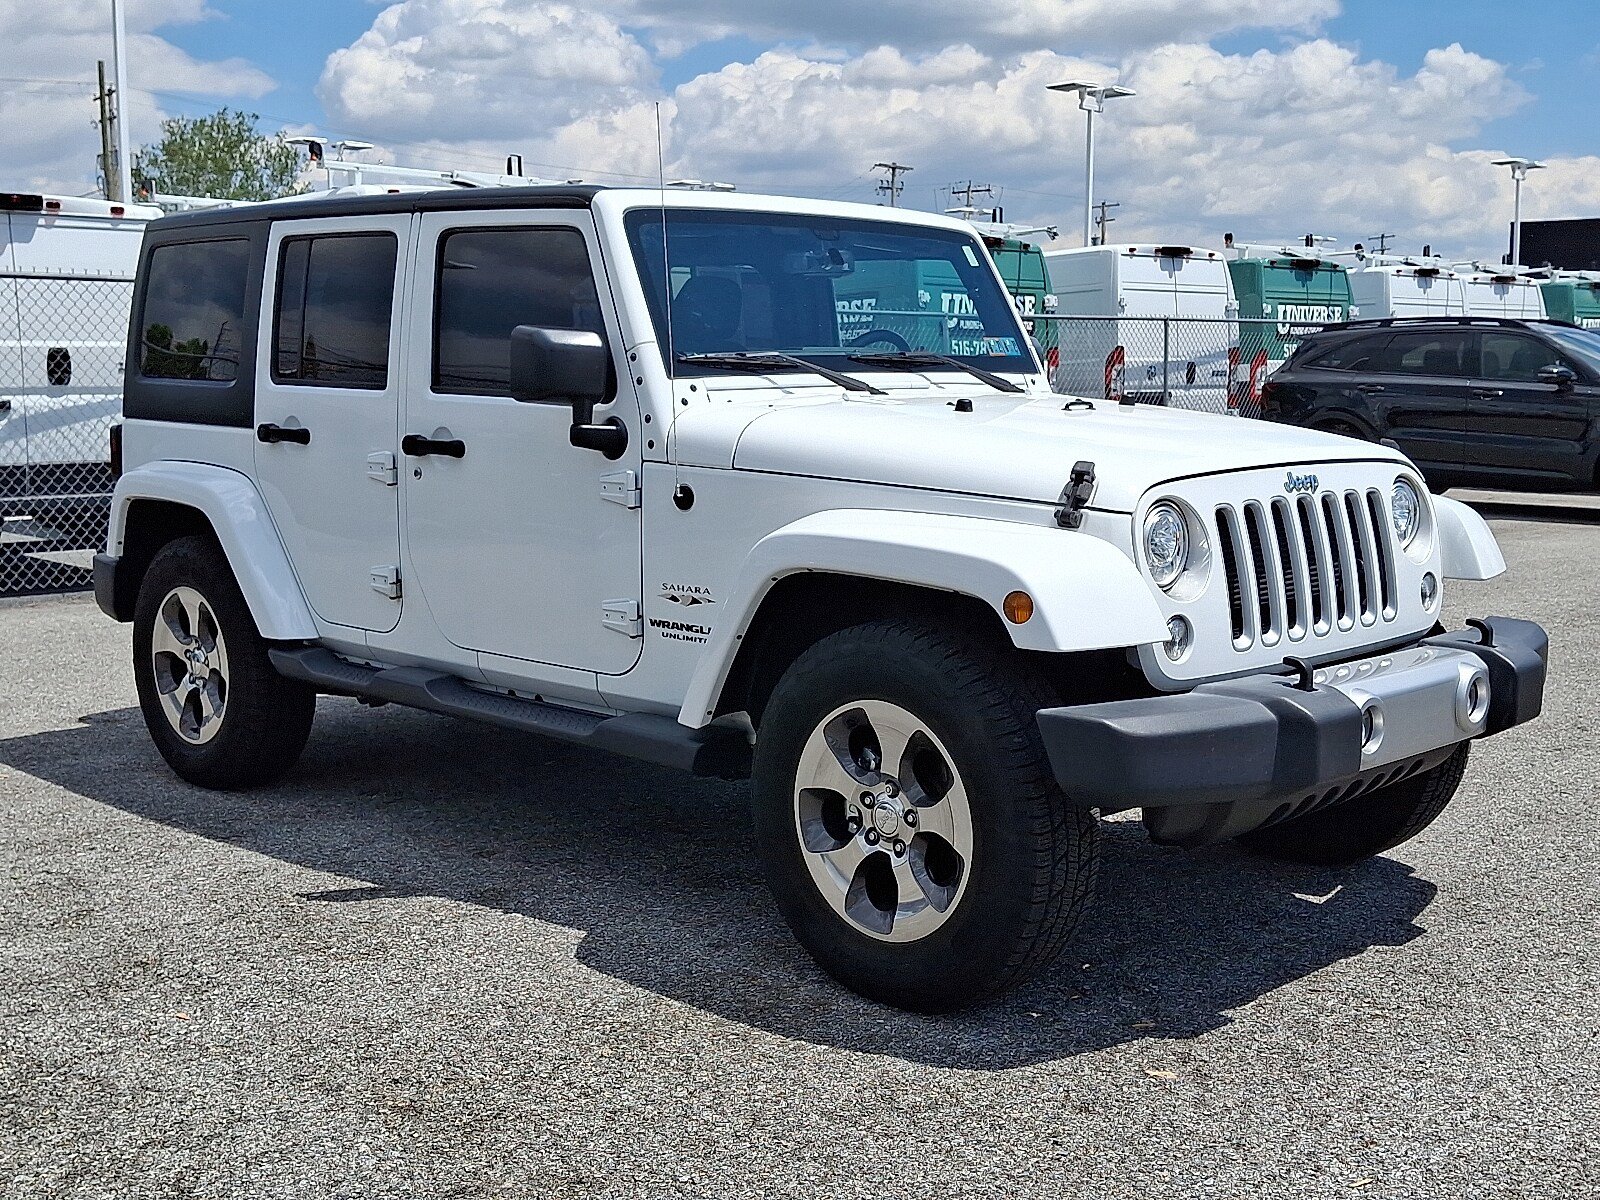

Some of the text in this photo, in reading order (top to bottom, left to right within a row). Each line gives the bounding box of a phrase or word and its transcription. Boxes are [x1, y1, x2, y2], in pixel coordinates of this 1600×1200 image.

[1277, 304, 1342, 335] UNIVERSE
[1284, 471, 1319, 494] Jeep
[661, 583, 711, 595] SAHARA
